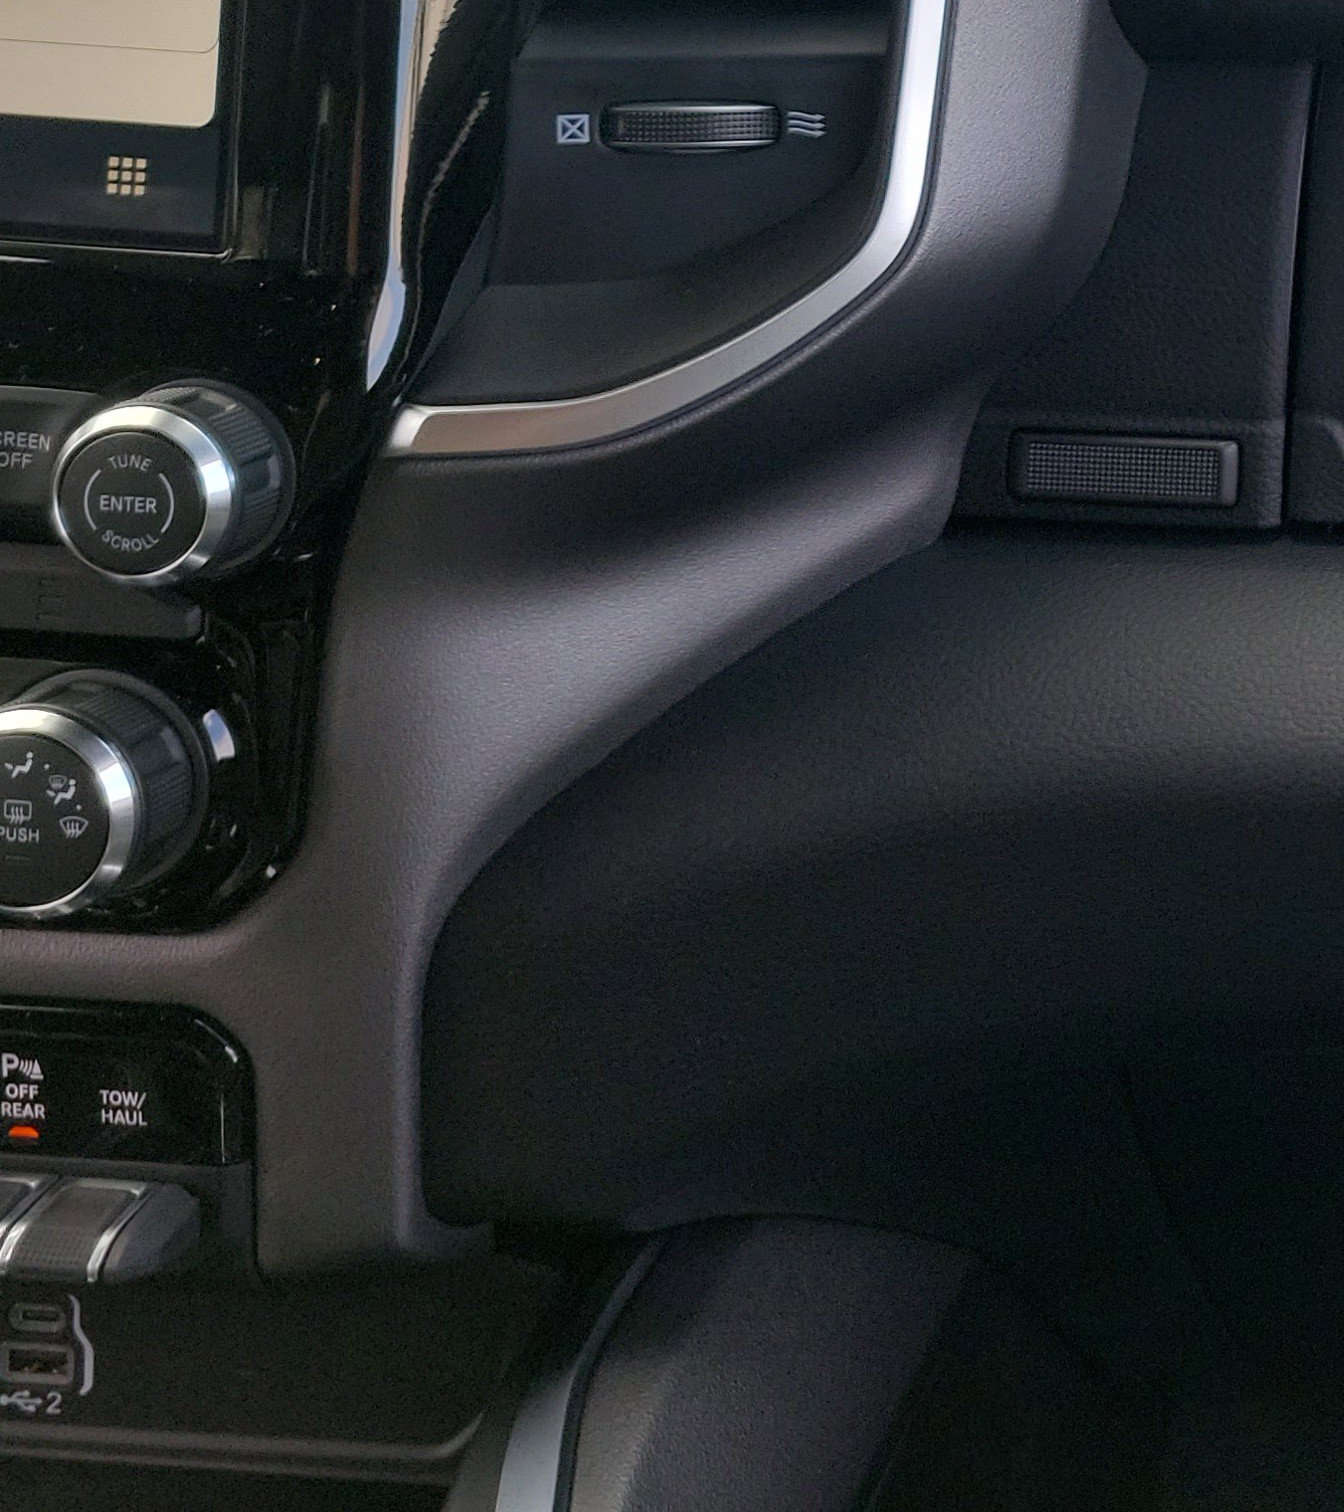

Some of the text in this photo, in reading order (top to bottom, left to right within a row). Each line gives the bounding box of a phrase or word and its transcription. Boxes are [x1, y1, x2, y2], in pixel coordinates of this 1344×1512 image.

[0, 431, 50, 451] REEN
[107, 454, 152, 472] TUNE
[99, 494, 157, 514] ENTER
[101, 529, 160, 552] SCROLL
[5, 1083, 39, 1100] OFF
[99, 1089, 147, 1109] TOW/
[0, 1101, 45, 1120] REAR
[101, 1109, 148, 1126] HAUL
[45, 1390, 62, 1415] 2
